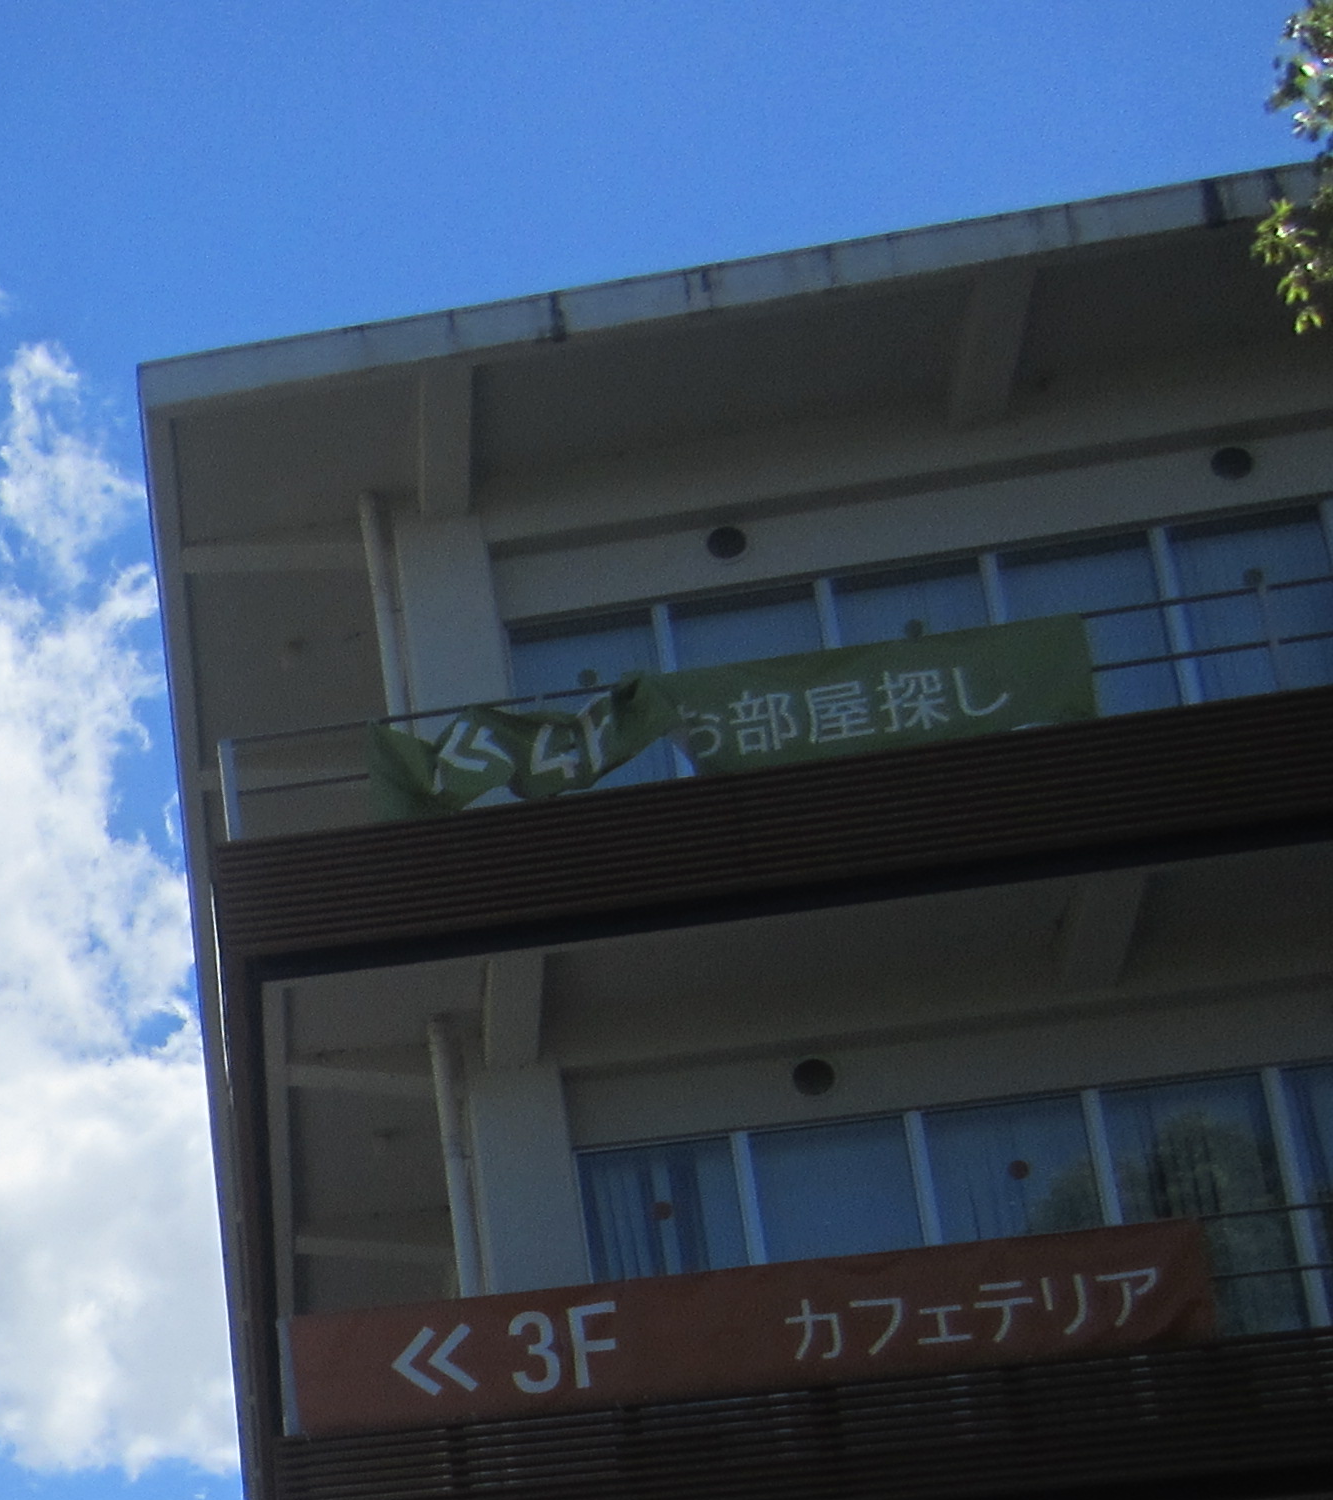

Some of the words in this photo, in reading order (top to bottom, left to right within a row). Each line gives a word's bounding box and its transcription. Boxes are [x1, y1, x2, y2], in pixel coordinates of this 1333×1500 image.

[507, 1300, 618, 1396] 3F
[781, 1266, 1161, 1364] カフェテリア
